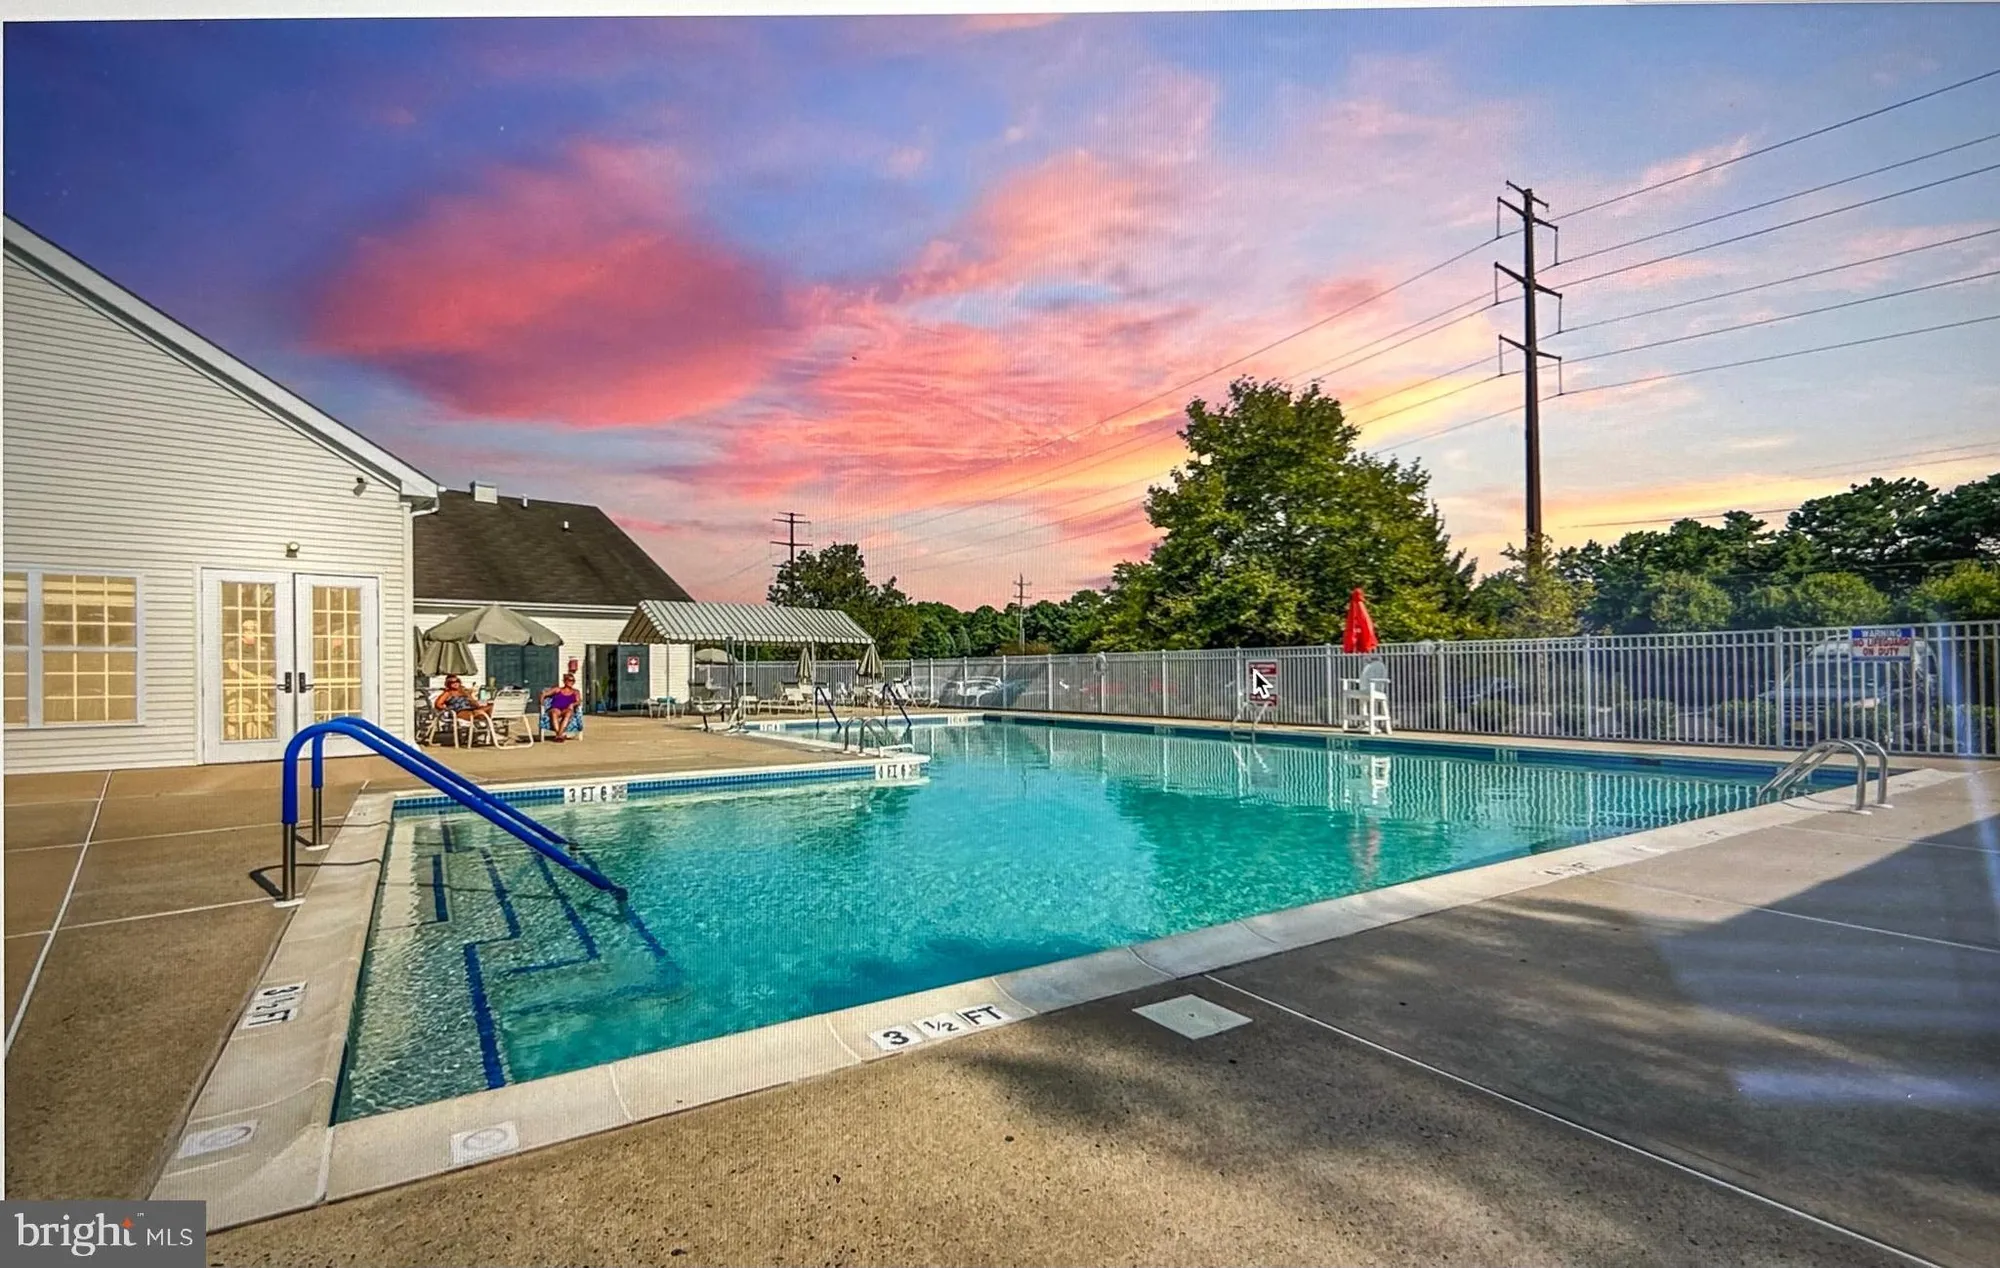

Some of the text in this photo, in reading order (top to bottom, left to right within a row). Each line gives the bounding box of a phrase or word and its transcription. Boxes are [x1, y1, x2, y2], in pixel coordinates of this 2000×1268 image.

[1861, 628, 1902, 638] WARNING
[1853, 637, 1910, 647] NO LIFEGUARD
[1863, 647, 1899, 656] ON DUTY
[569, 788, 576, 802] 3
[581, 786, 595, 802] FT
[883, 1030, 909, 1045] 3
[962, 1006, 1001, 1025] FT
